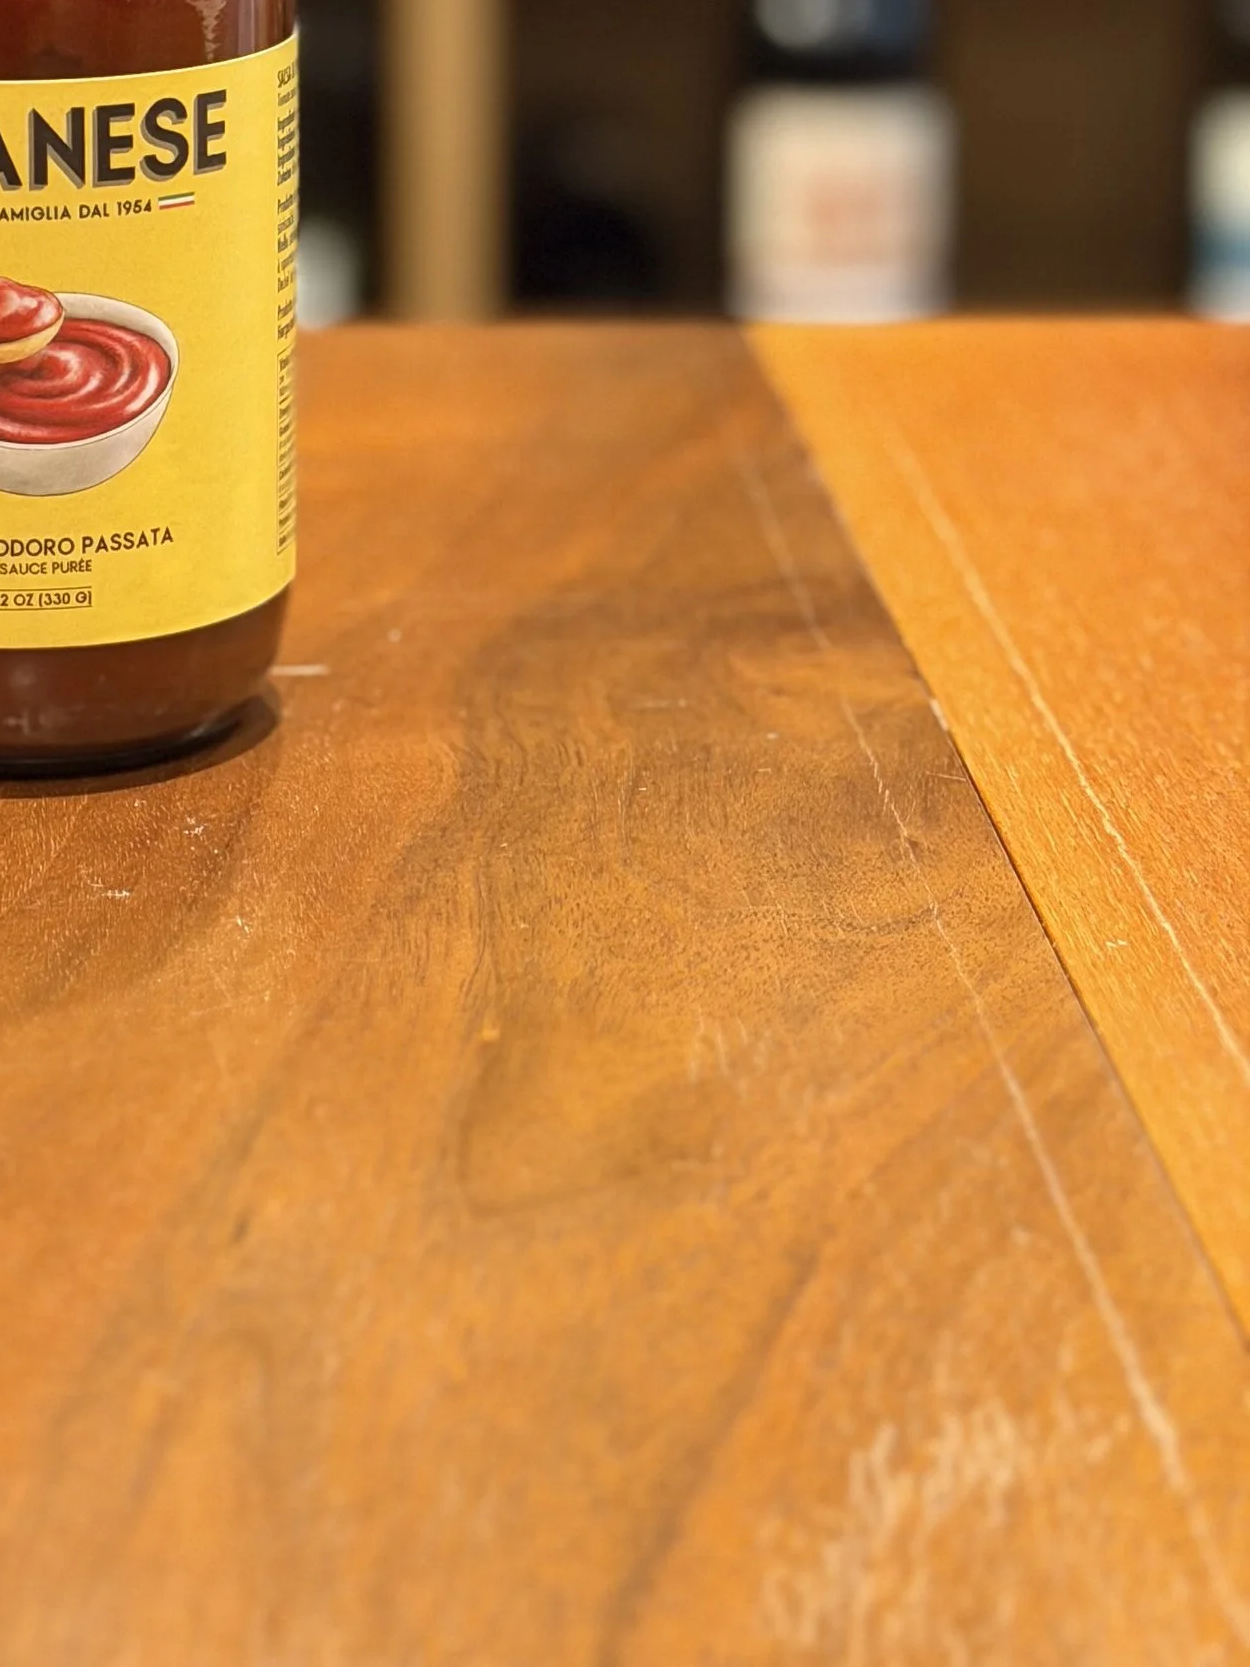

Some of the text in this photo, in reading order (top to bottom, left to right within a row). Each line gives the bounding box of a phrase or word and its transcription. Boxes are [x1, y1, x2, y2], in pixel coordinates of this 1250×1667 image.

[78, 200, 110, 219] DAL
[81, 525, 174, 554] PASSATA
[0, 561, 48, 575] SAUCE
[13, 592, 34, 606] OZ
[38, 591, 70, 607] (330
